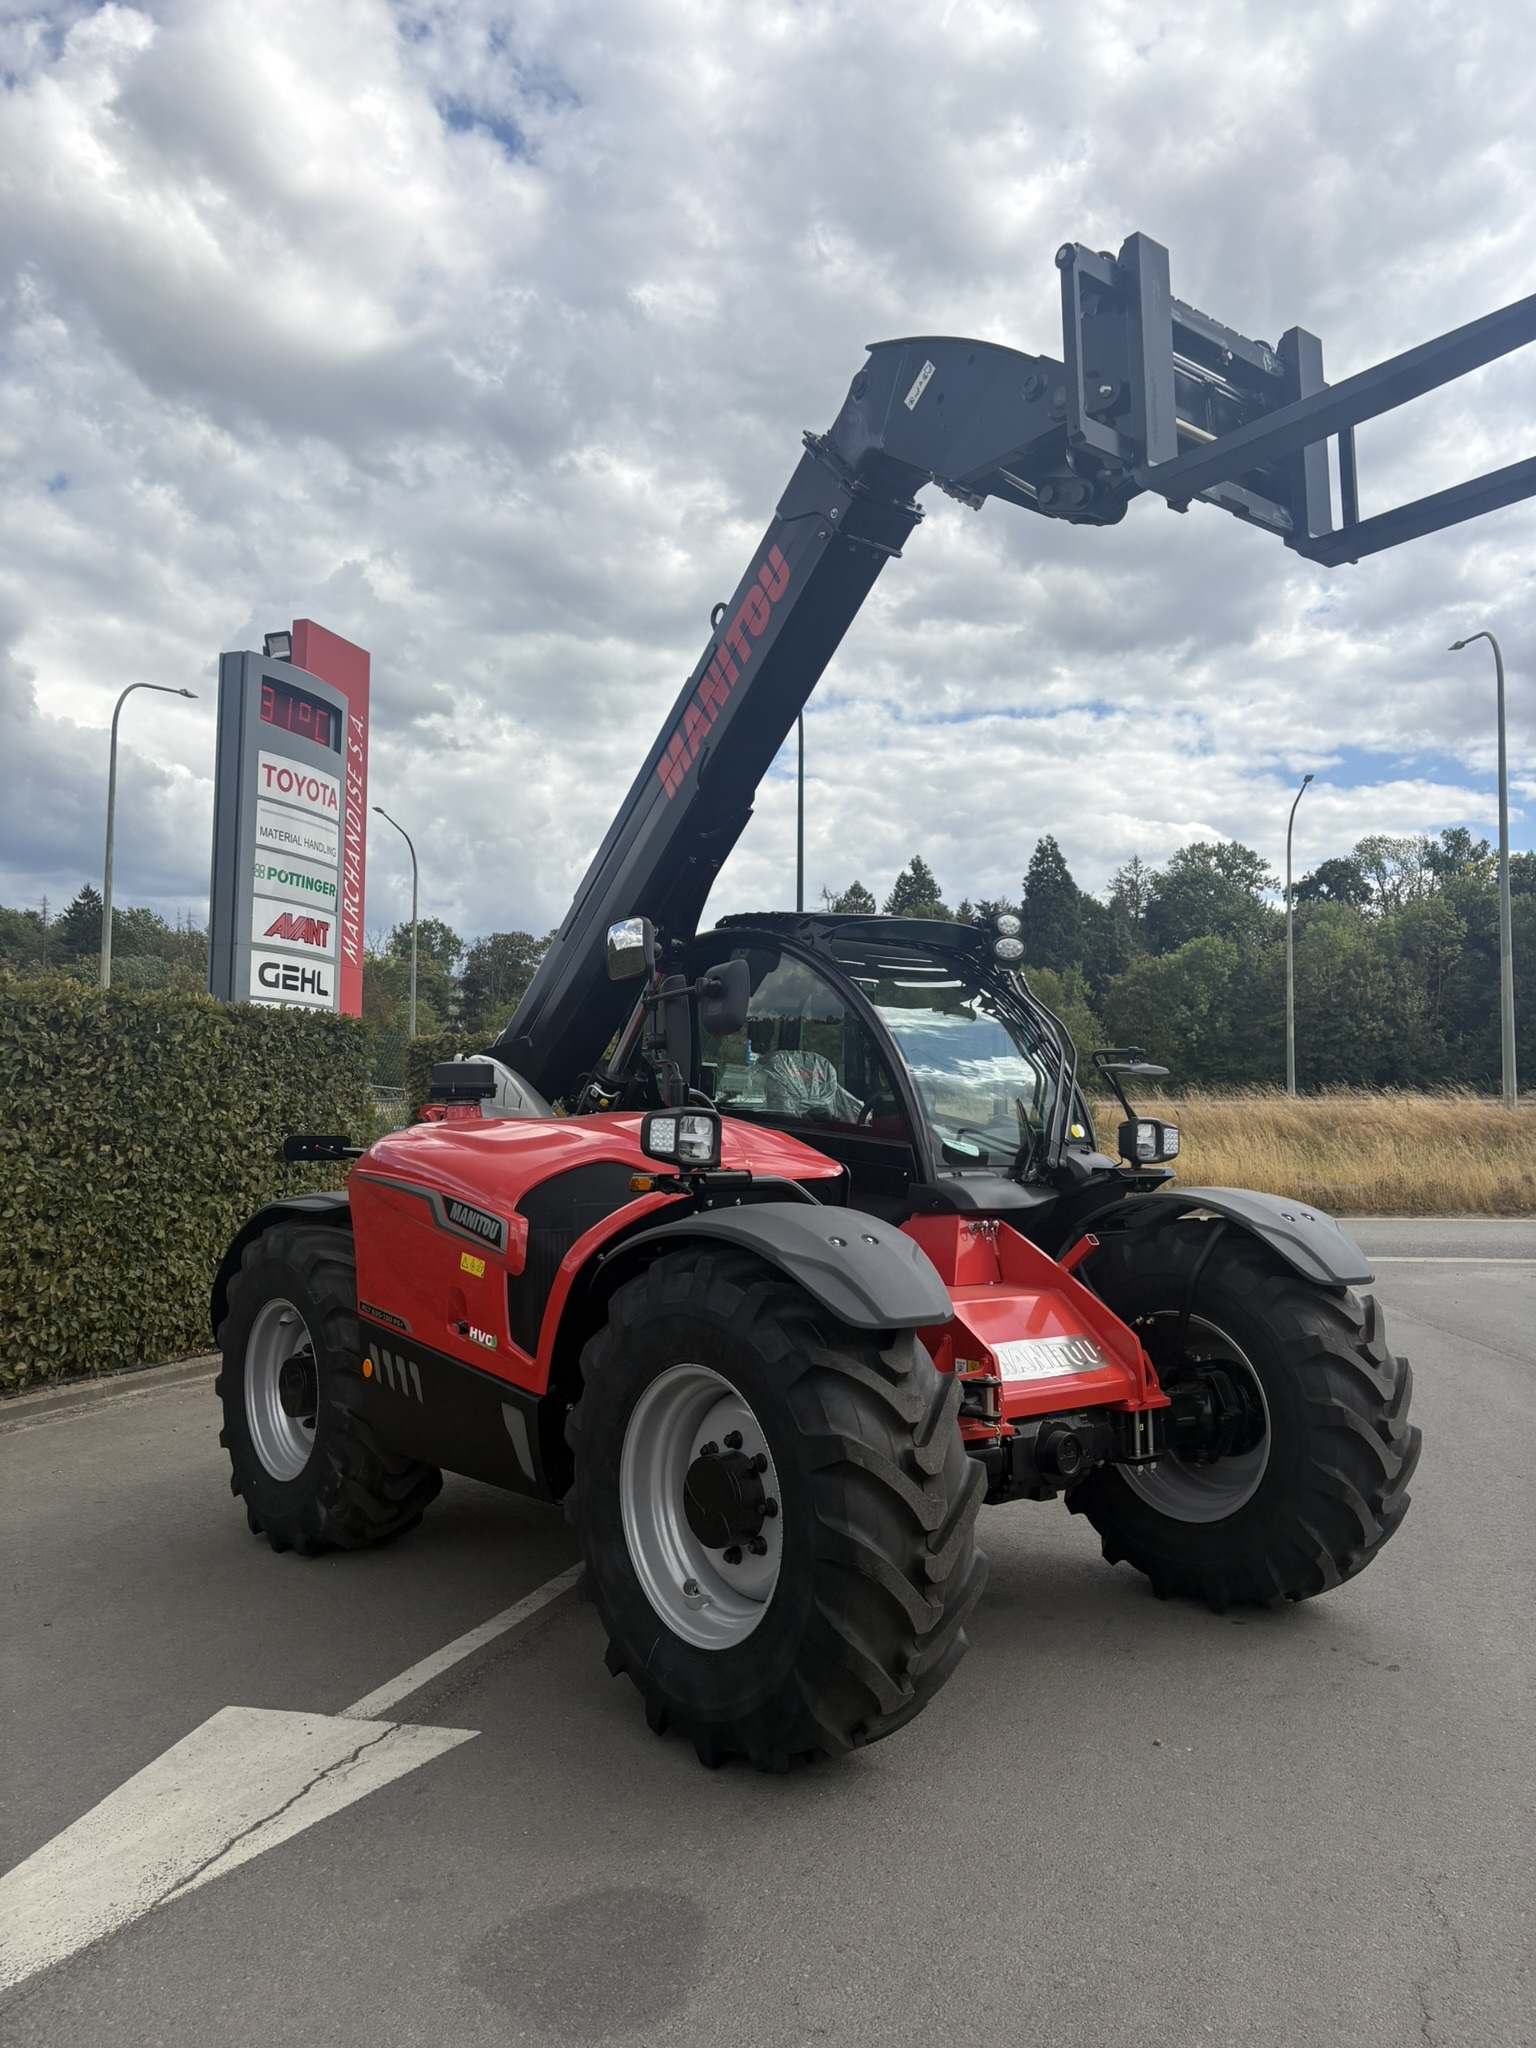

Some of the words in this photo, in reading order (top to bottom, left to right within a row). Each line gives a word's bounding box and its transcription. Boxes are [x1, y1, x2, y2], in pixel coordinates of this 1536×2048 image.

[656, 543, 790, 800] MANITOU
[348, 713, 364, 762] S.A.
[262, 763, 339, 811] TOYOTA
[260, 826, 302, 846] MATERIAL
[303, 837, 337, 857] HANDLING
[267, 866, 336, 897] PÖTTINGER
[342, 763, 363, 965] MARCHANDISE
[263, 912, 330, 948] AVANT
[258, 961, 330, 997] GEHL
[449, 1202, 500, 1240] MANITOU
